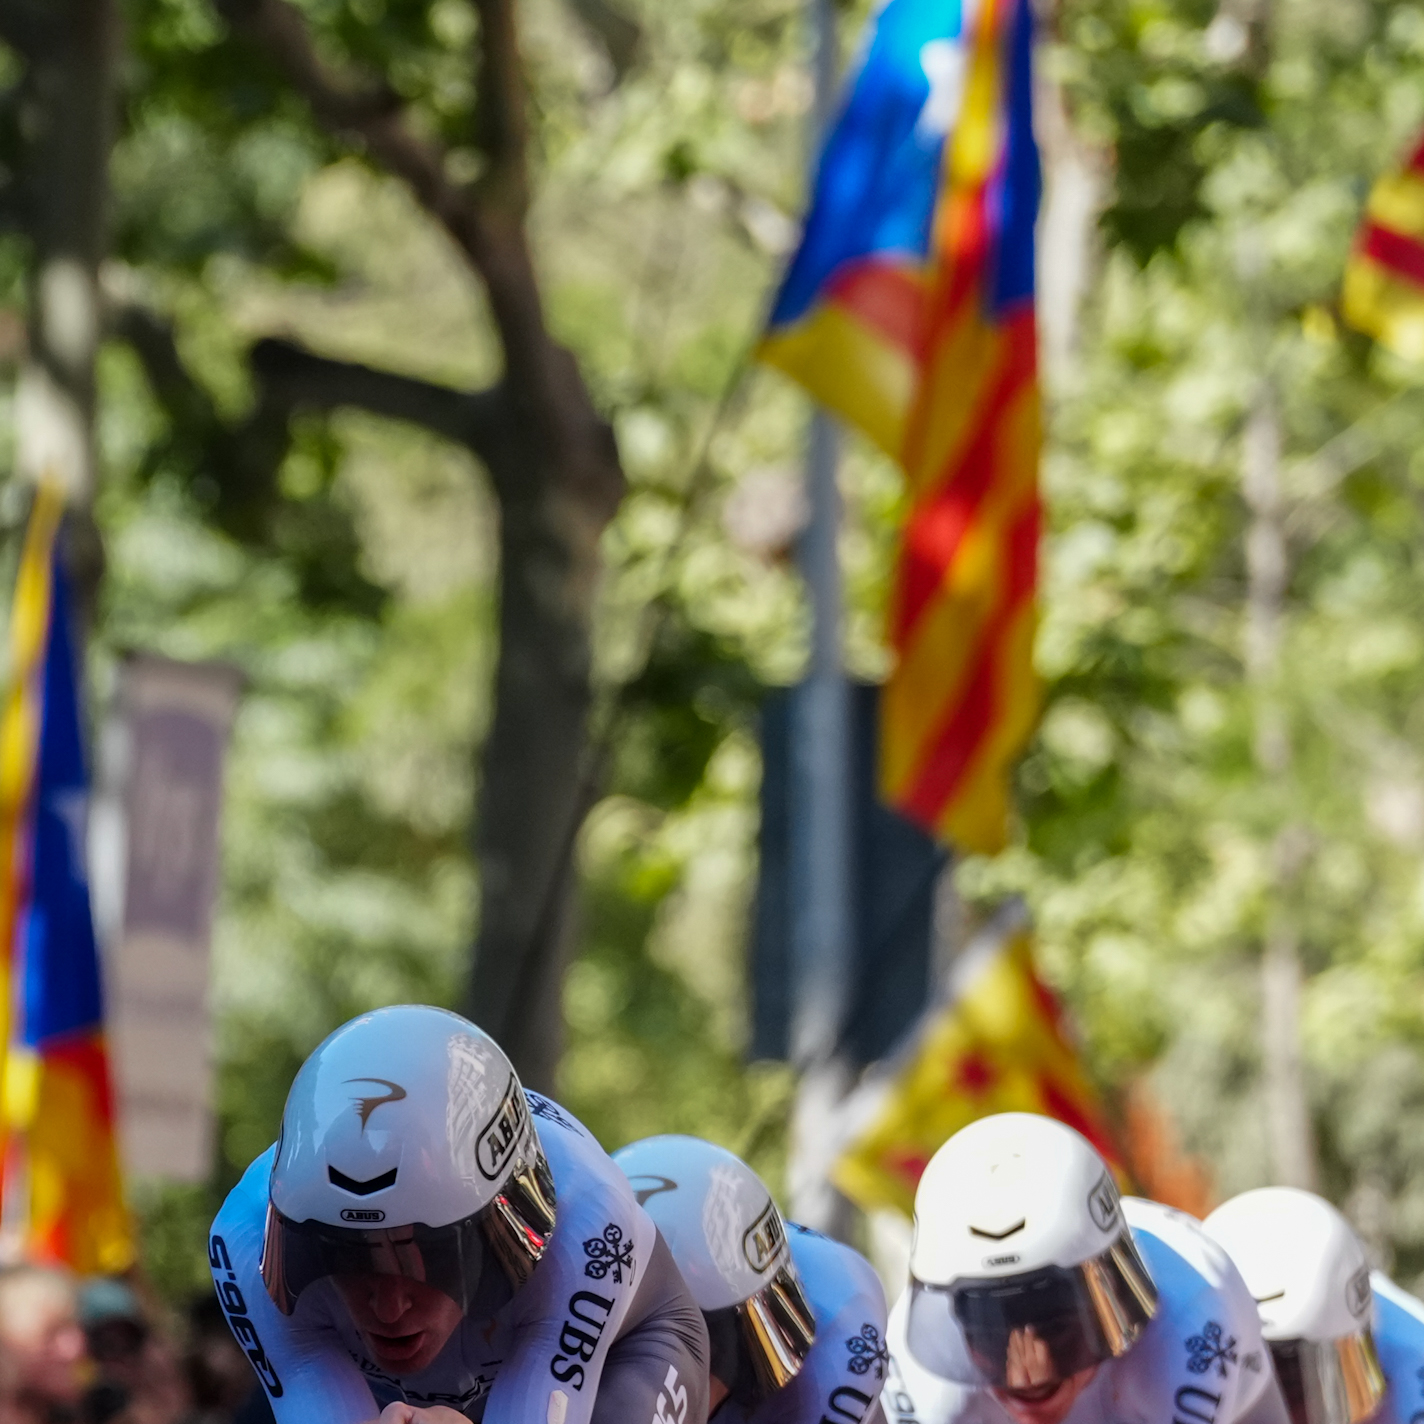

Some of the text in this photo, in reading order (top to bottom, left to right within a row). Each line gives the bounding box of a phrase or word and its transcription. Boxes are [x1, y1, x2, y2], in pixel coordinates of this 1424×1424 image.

[346, 1210, 380, 1221] ABUS
[208, 1234, 284, 1399] Q36.5
[549, 1289, 616, 1392] UBS
